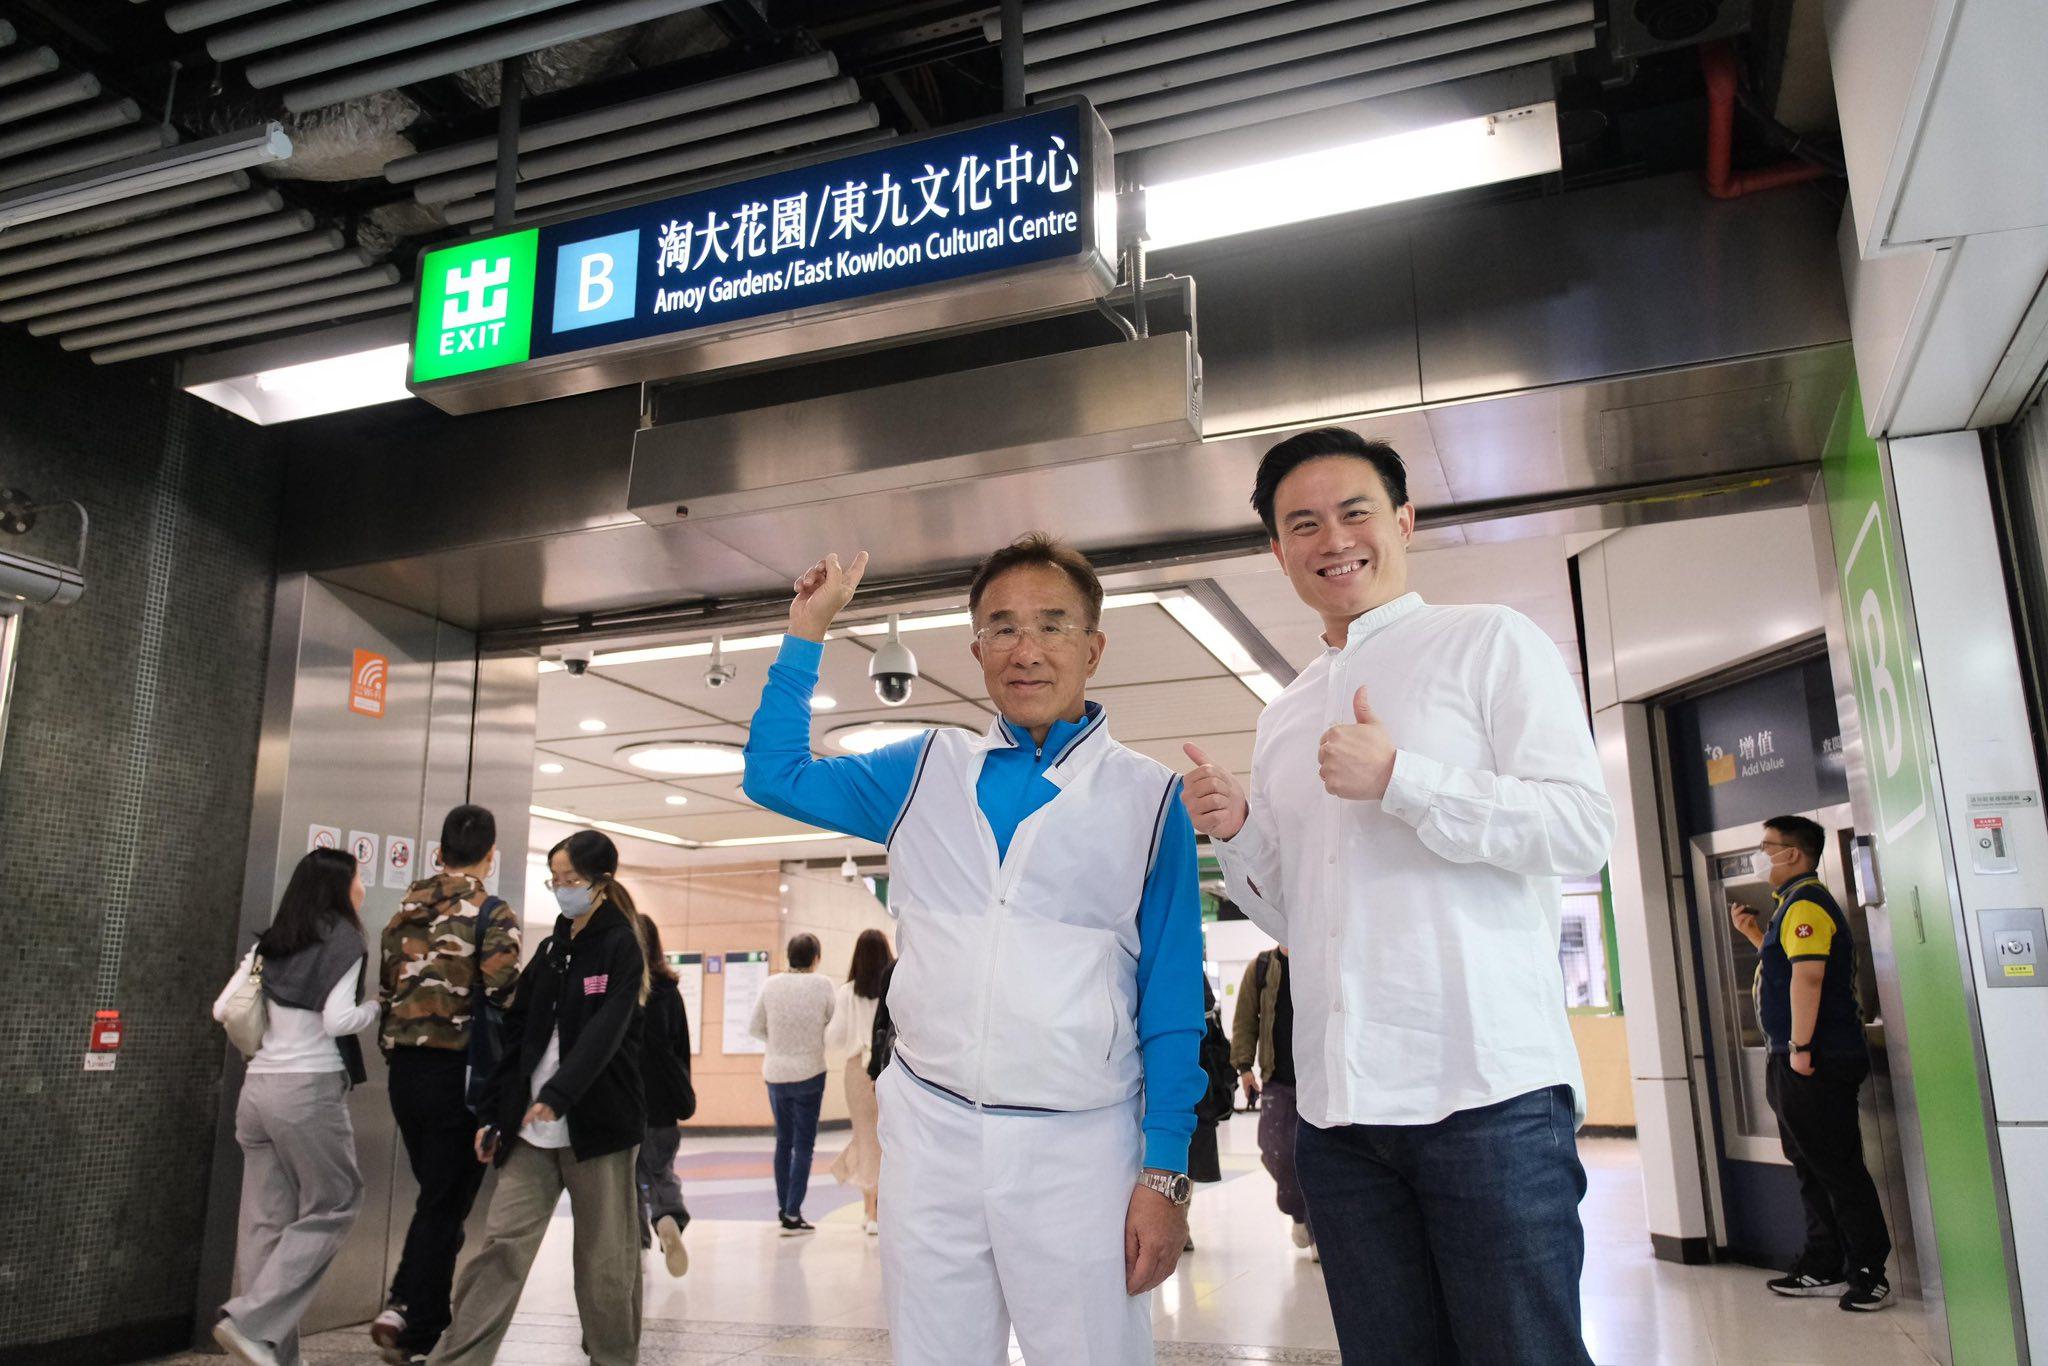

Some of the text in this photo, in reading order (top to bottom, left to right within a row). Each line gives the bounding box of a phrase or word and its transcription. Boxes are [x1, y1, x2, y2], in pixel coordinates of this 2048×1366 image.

[577, 252, 615, 313] B
[653, 284, 706, 315] Amoy
[836, 241, 921, 278] Kowloon
[926, 218, 1003, 257] Cultural
[1009, 210, 1078, 242] Centre
[439, 321, 506, 357] EXIT
[1860, 588, 1903, 779] B
[1739, 731, 1774, 760] 增值
[1741, 757, 1785, 777] Add Value
